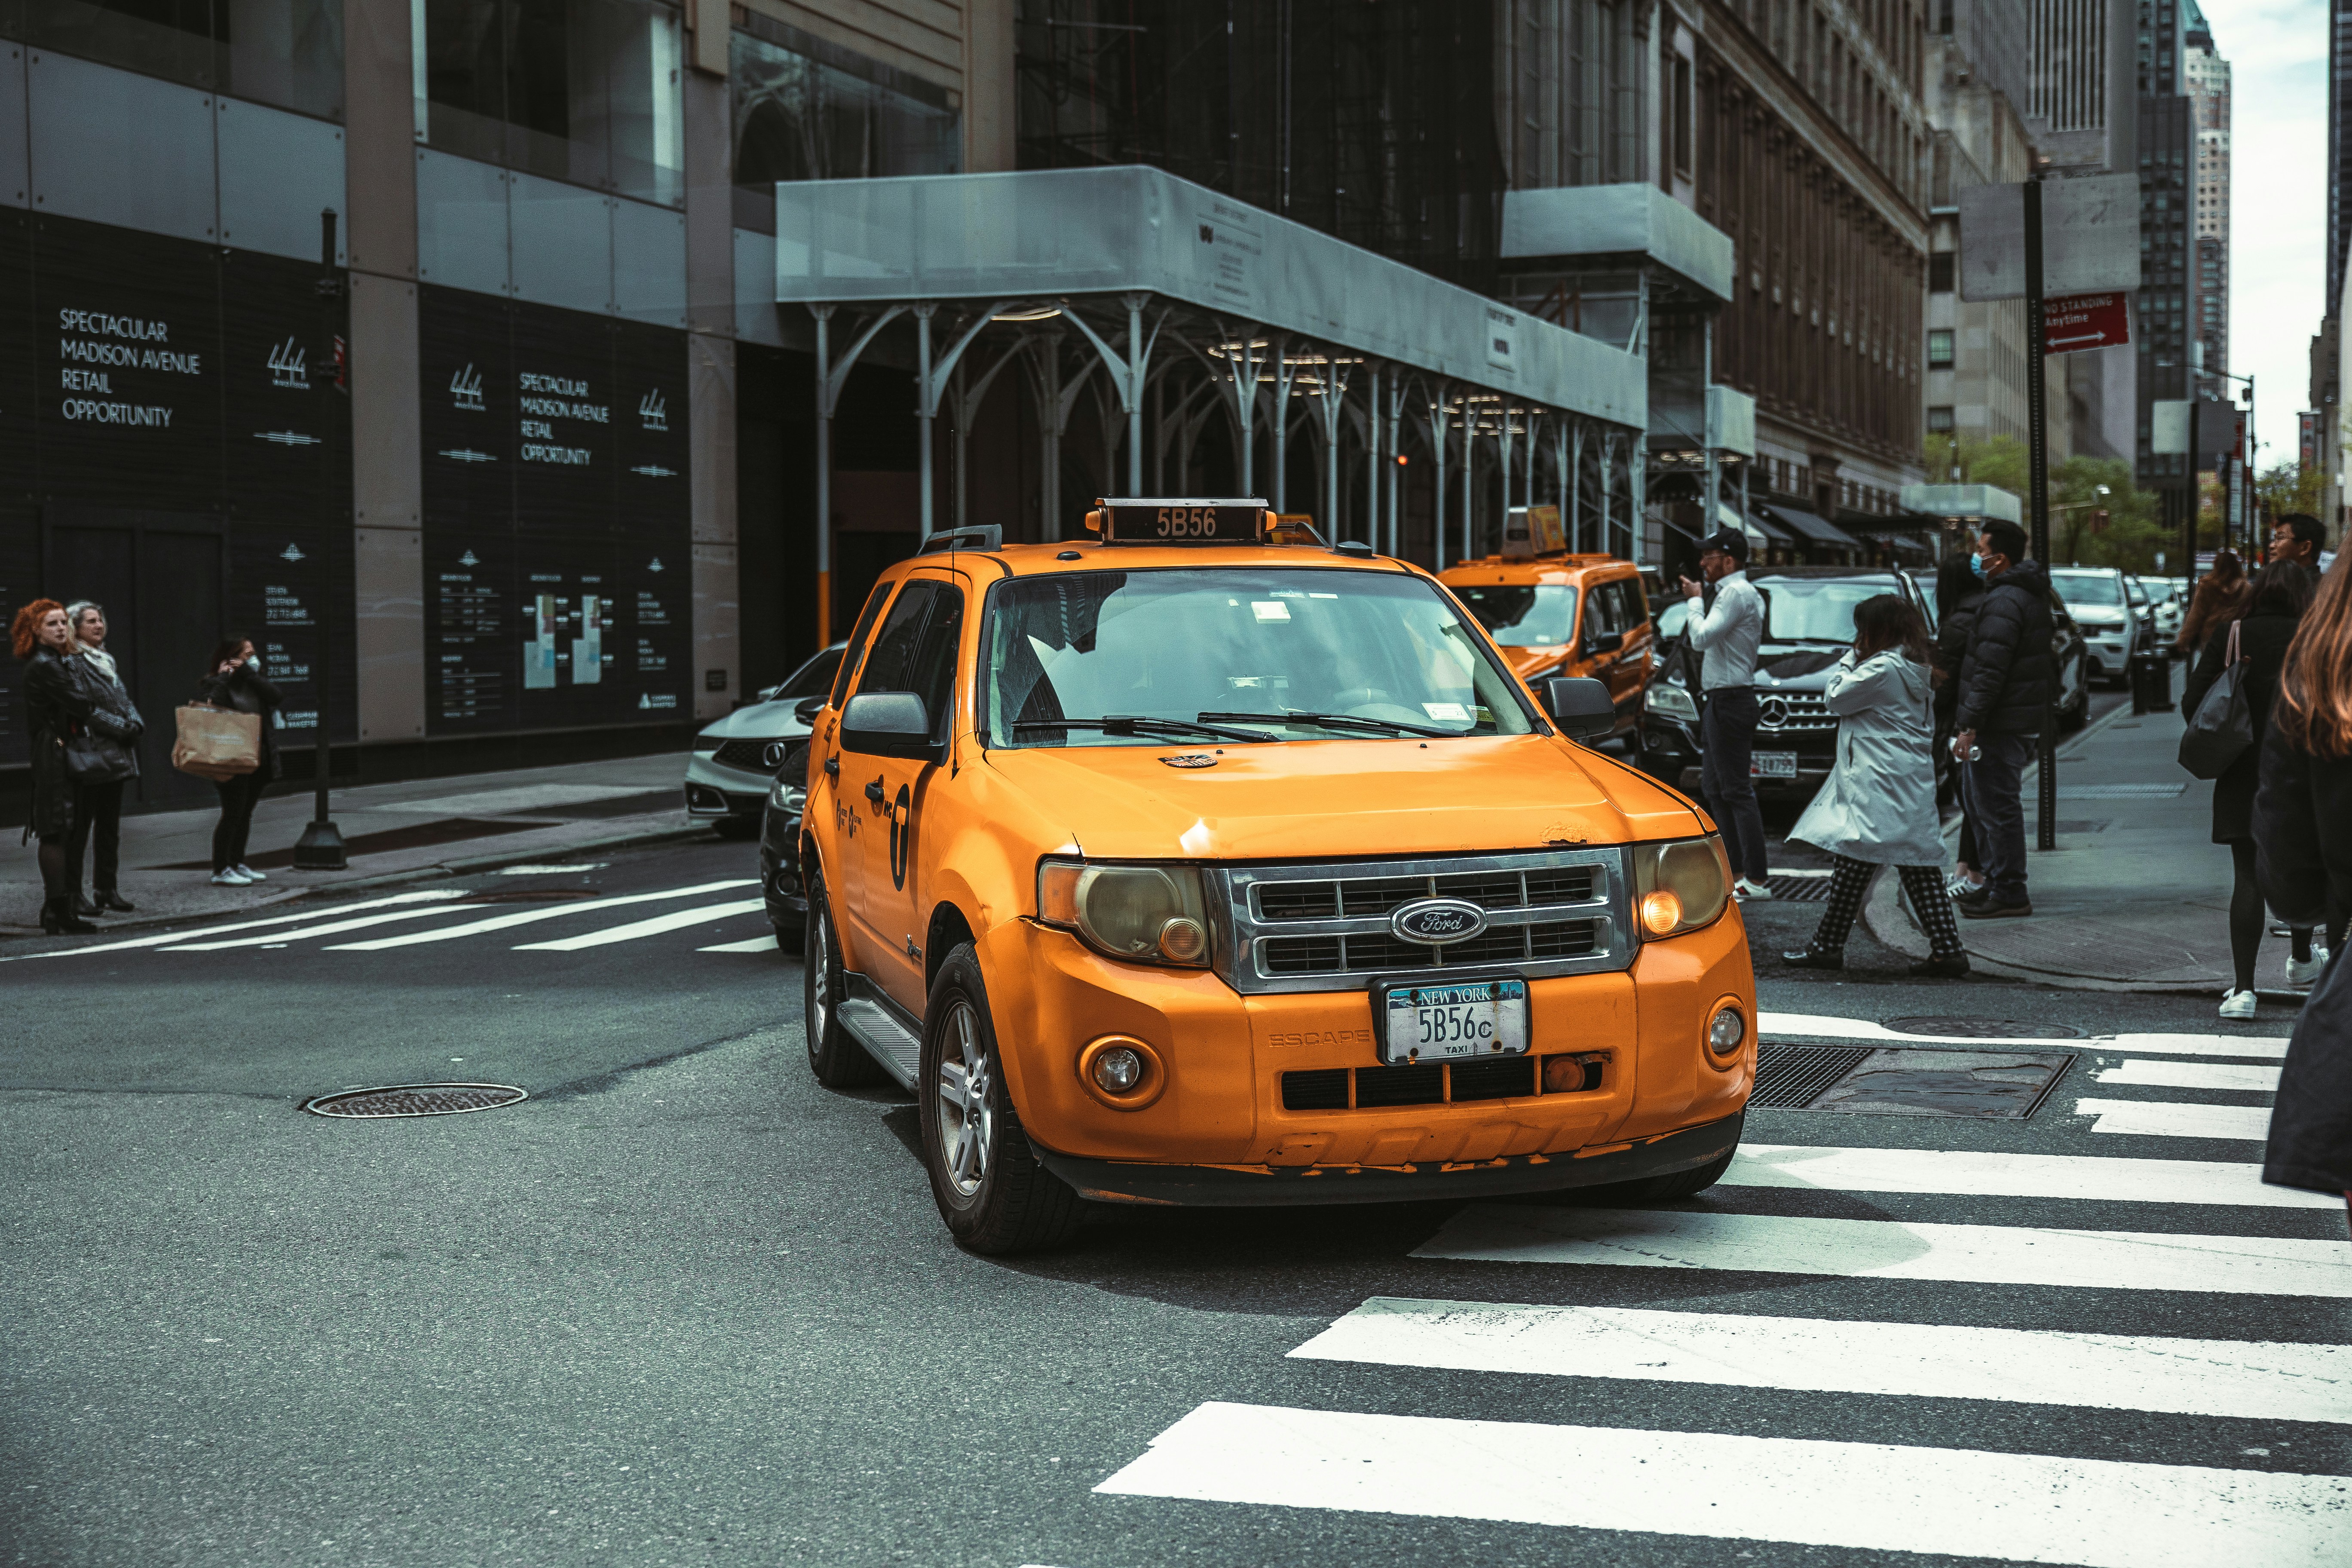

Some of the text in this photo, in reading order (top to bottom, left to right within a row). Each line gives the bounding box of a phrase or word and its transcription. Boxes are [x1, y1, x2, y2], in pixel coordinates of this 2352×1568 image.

[2043, 296, 2112, 313] NO STANDING
[60, 308, 168, 342] SPECTACULAR
[2046, 314, 2089, 328] Anytime
[61, 338, 201, 374] MADISON AVENUE
[61, 368, 113, 394] RETAIL
[520, 372, 588, 397] SPECTACULAR
[62, 398, 172, 427] OPPORTUNITY
[520, 396, 609, 423] MADISON AVENUE
[521, 419, 554, 439] RETAIL
[521, 443, 591, 465] OPPORTUNITY
[1157, 507, 1216, 537] 5B56
[883, 800, 893, 819] NYC
[1421, 912, 1462, 931] Ford
[1421, 987, 1491, 1005] NEW YORK
[1269, 1029, 1370, 1048] ESCAPE
[1446, 1045, 1467, 1054] TAXI
